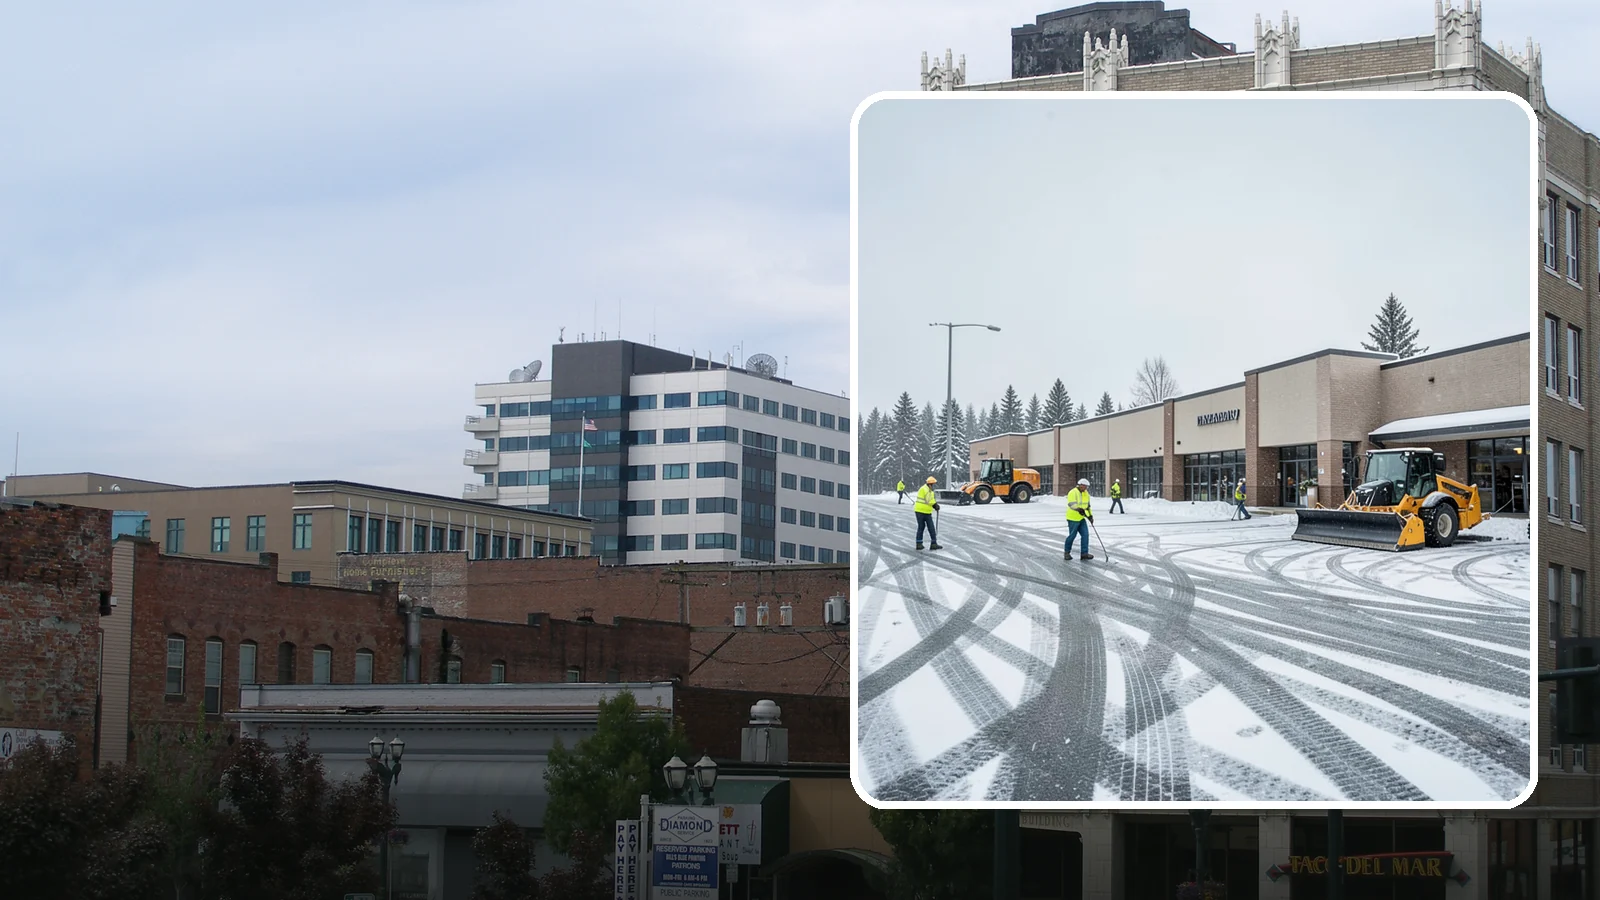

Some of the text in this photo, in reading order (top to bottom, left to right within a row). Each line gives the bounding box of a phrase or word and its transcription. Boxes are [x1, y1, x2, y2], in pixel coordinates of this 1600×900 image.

[343, 566, 427, 577] Home Furnishers
[660, 818, 713, 832] DIAMOND
[1022, 815, 1069, 827] BUILDING
[656, 845, 716, 854] RESERVED PARKING
[617, 825, 625, 893] PAY HERE
[628, 825, 636, 893] PAY HERE
[722, 851, 739, 862] Soup
[671, 862, 701, 870] PATRONS
[1289, 856, 1442, 877] TAC DEL MAR
[660, 889, 710, 898] PUBLIC PARKING
